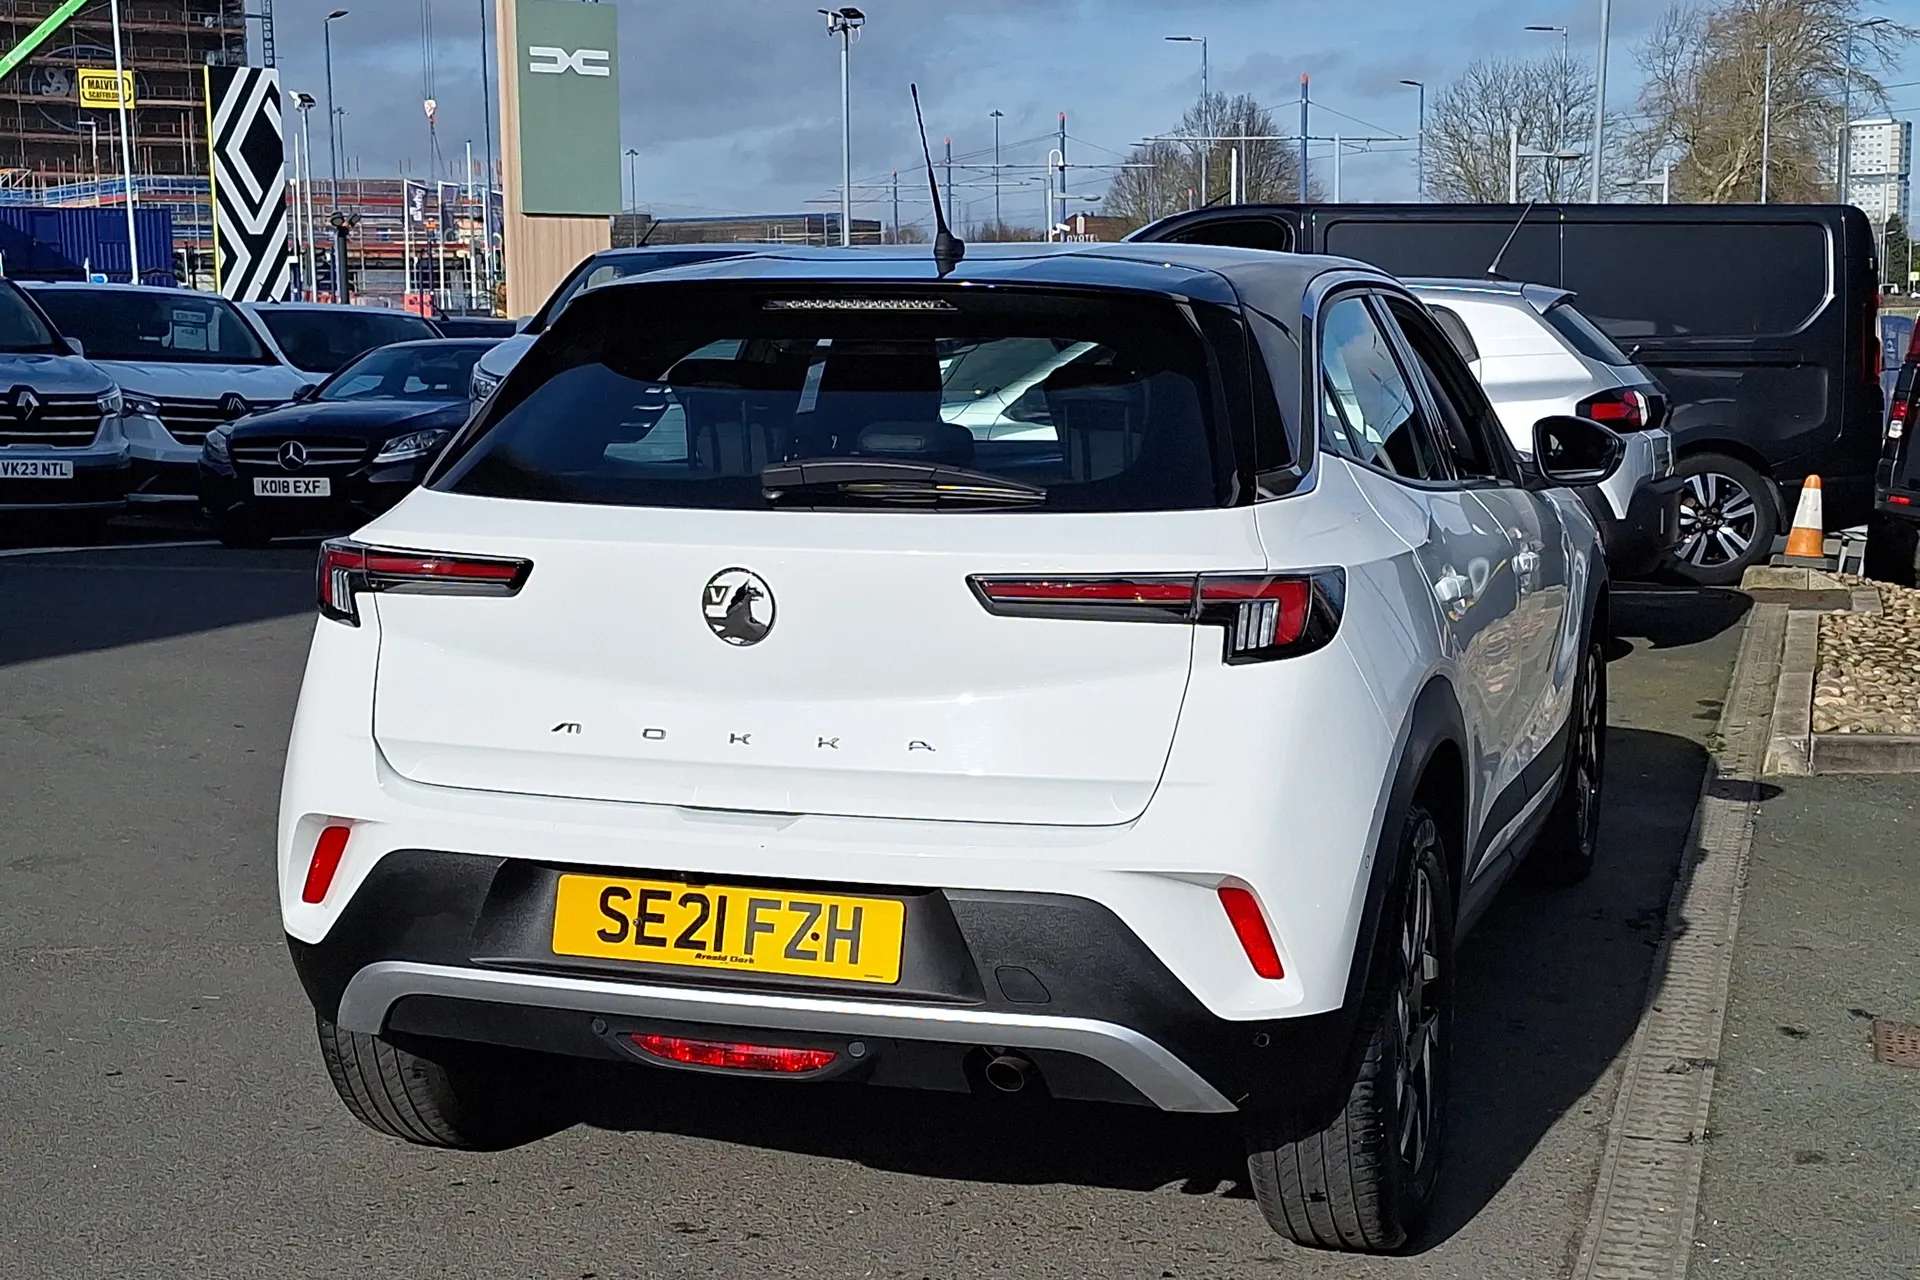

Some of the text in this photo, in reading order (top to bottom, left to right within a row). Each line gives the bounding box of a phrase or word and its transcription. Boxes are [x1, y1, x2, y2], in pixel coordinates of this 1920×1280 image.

[88, 79, 120, 90] MALVER
[1, 462, 68, 476] VK23 NTL
[261, 480, 320, 494] KO18 EXF
[551, 722, 937, 752] MOKKA
[596, 885, 863, 965] SE21 FZH
